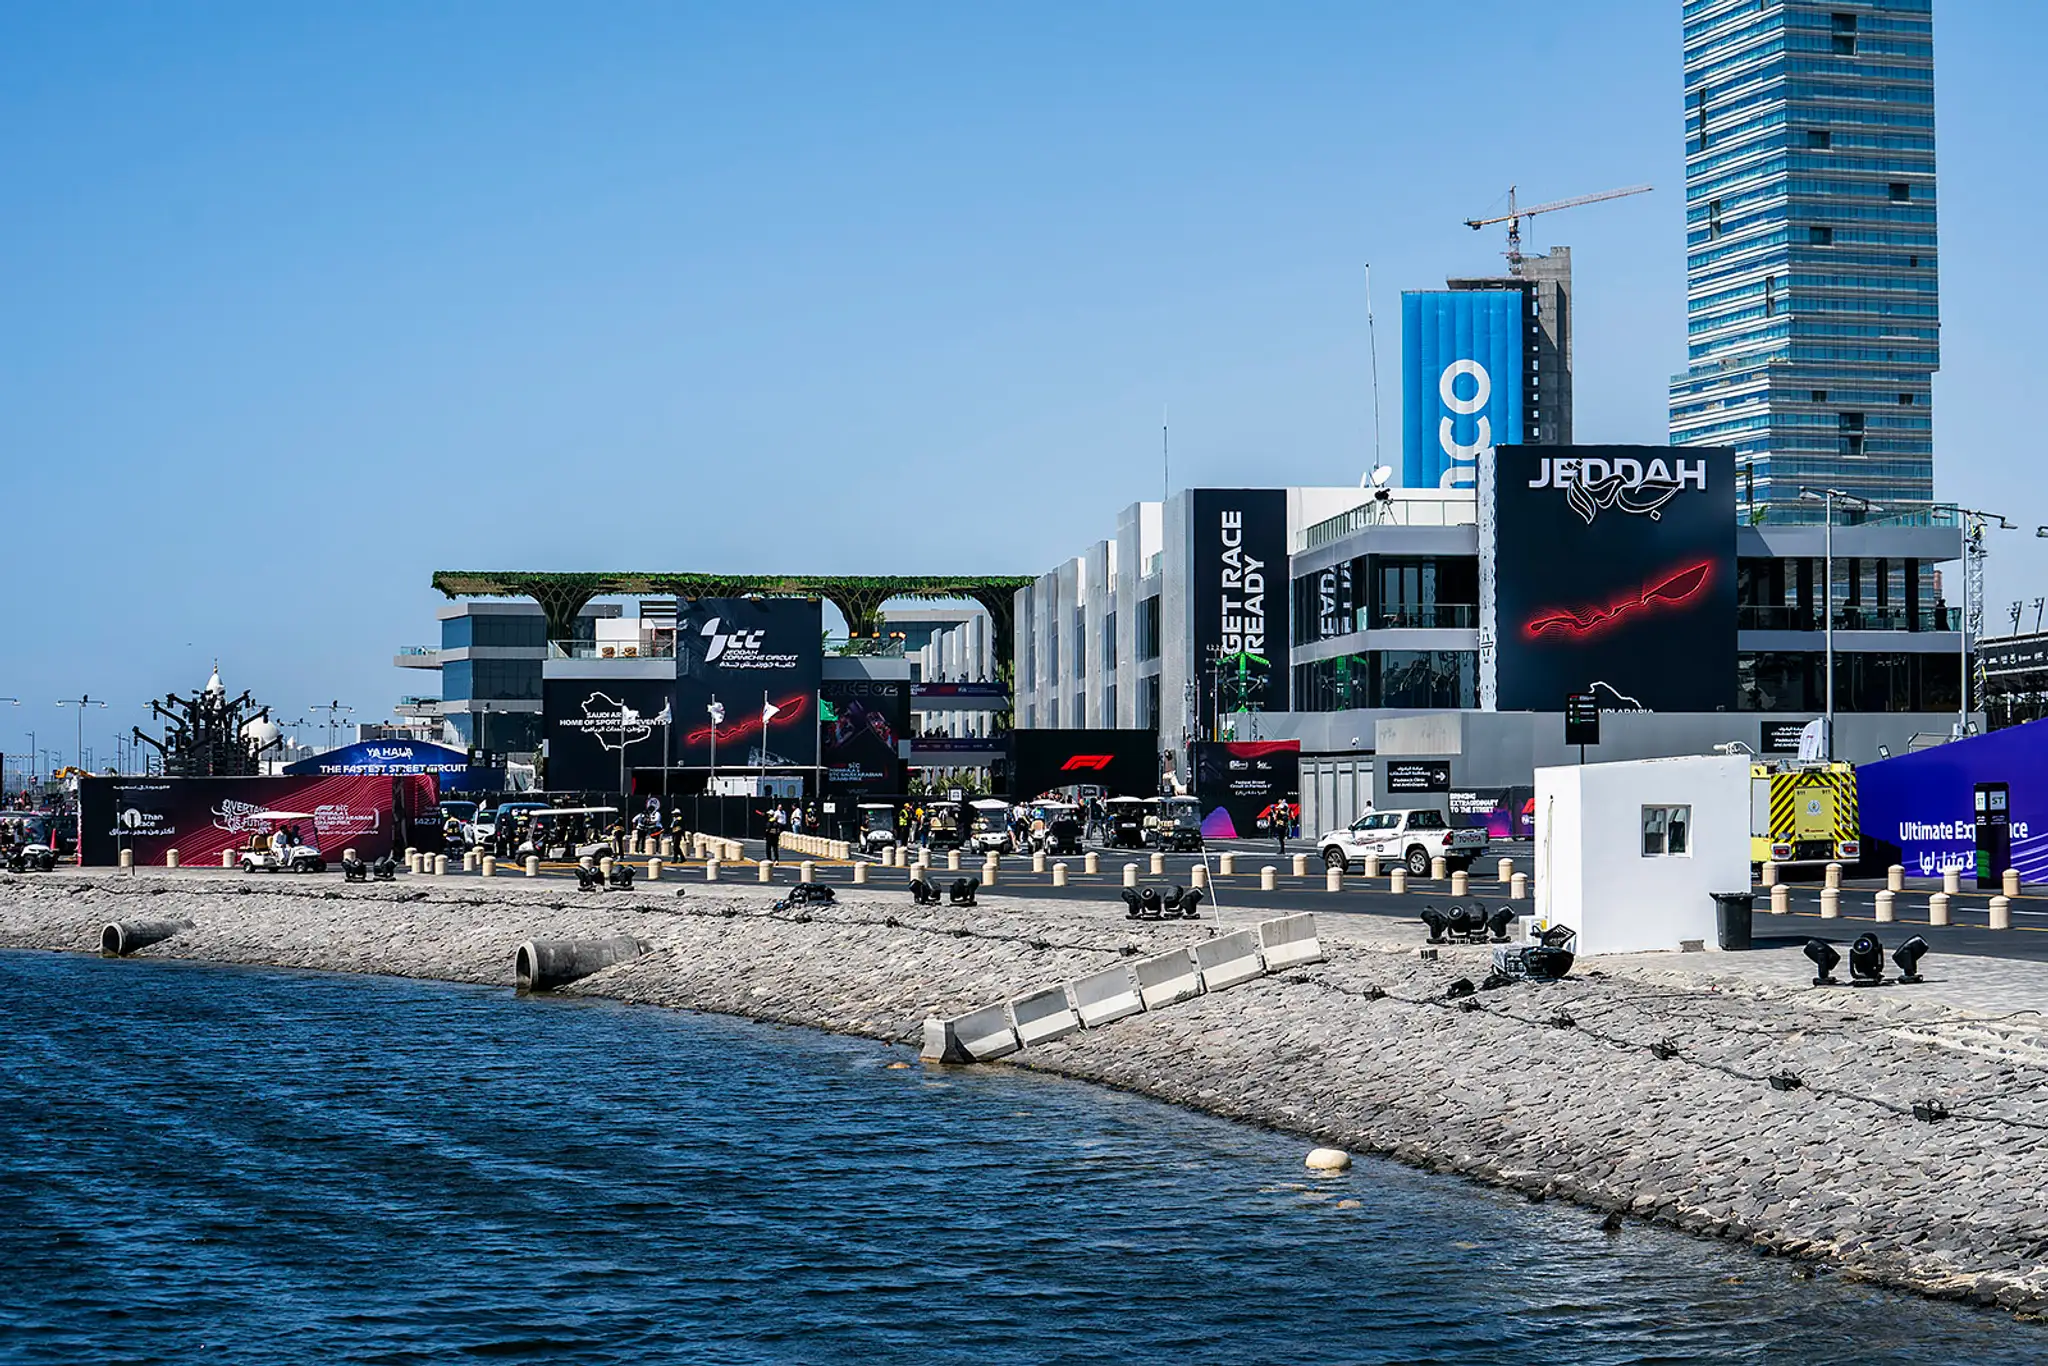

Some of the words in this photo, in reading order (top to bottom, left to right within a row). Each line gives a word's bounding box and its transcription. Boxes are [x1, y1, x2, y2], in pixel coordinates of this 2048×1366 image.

[1528, 458, 1707, 490] JEDDAH
[1221, 511, 1242, 588] RACE
[1244, 555, 1265, 654] READY
[1221, 594, 1242, 655] GET
[319, 765, 341, 773] THE
[343, 764, 386, 773] FASTEST
[388, 764, 426, 772] STREET
[142, 813, 164, 821] Than
[1899, 821, 1953, 841] Ultimate
[1919, 851, 1936, 876] لها
